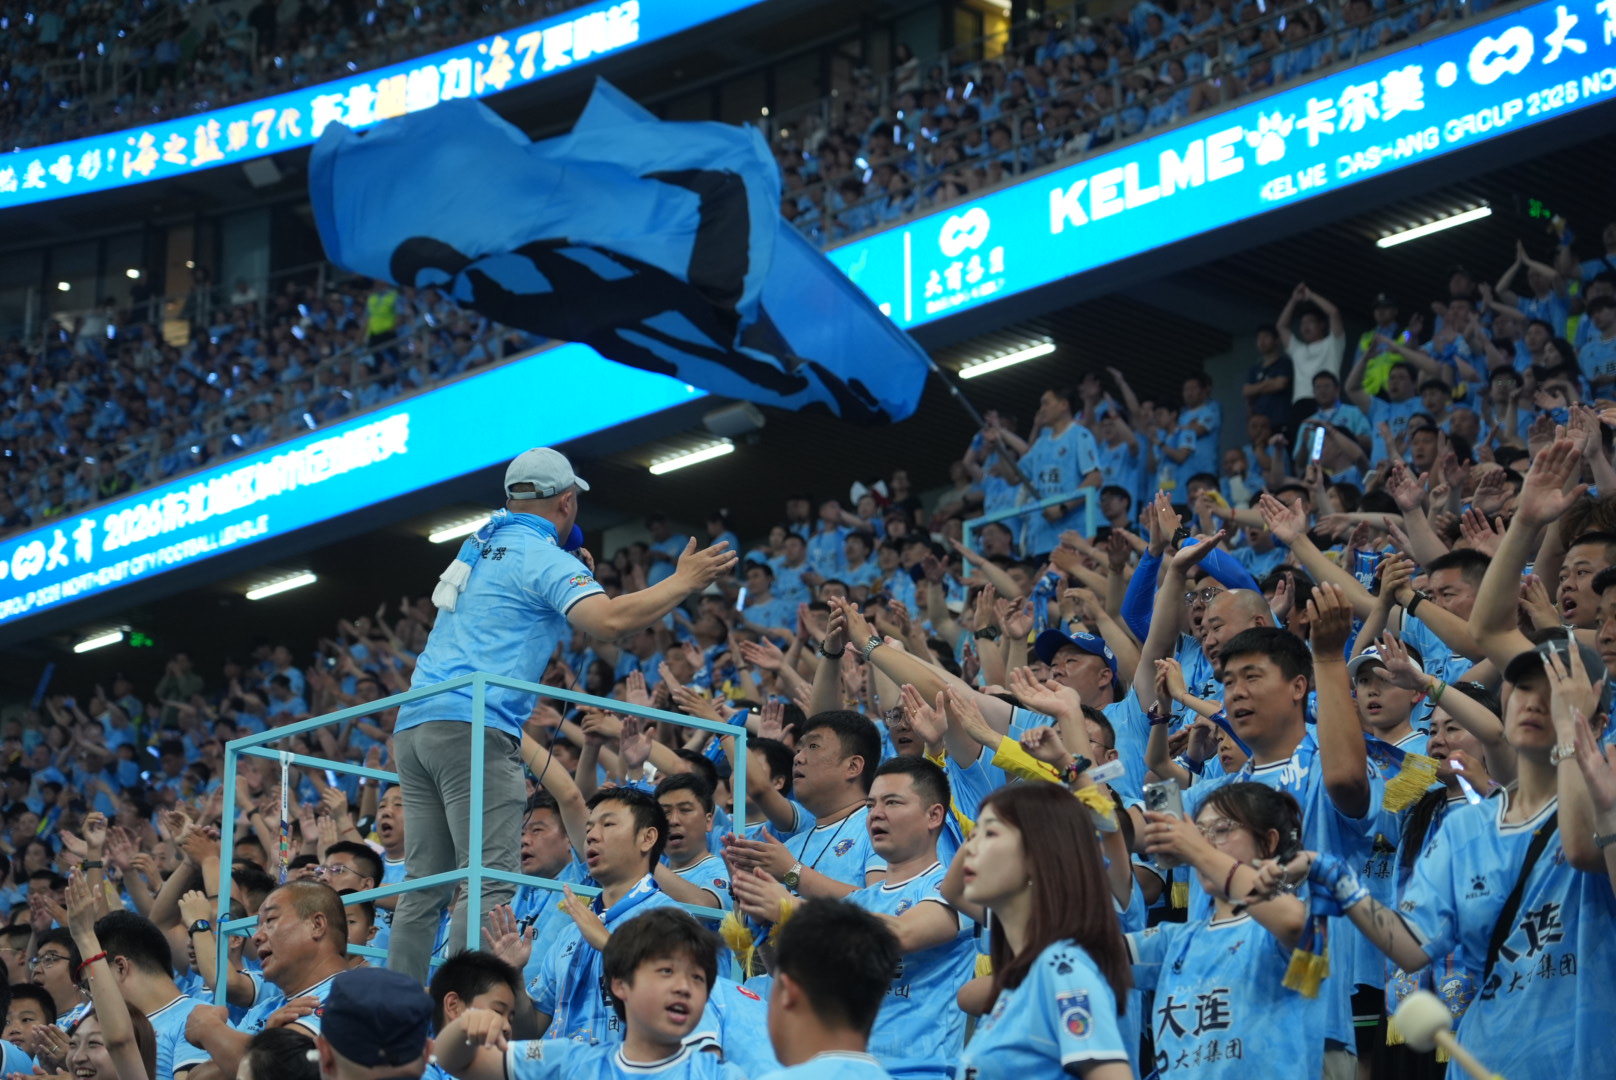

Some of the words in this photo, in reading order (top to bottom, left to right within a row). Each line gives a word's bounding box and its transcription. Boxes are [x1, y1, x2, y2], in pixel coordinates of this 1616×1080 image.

[1260, 163, 1328, 202] KELME
[1444, 98, 1524, 143] GROUP
[1295, 64, 1425, 147] 卡尔美
[1050, 126, 1244, 235] KELME
[1155, 987, 1232, 1043] 大连
